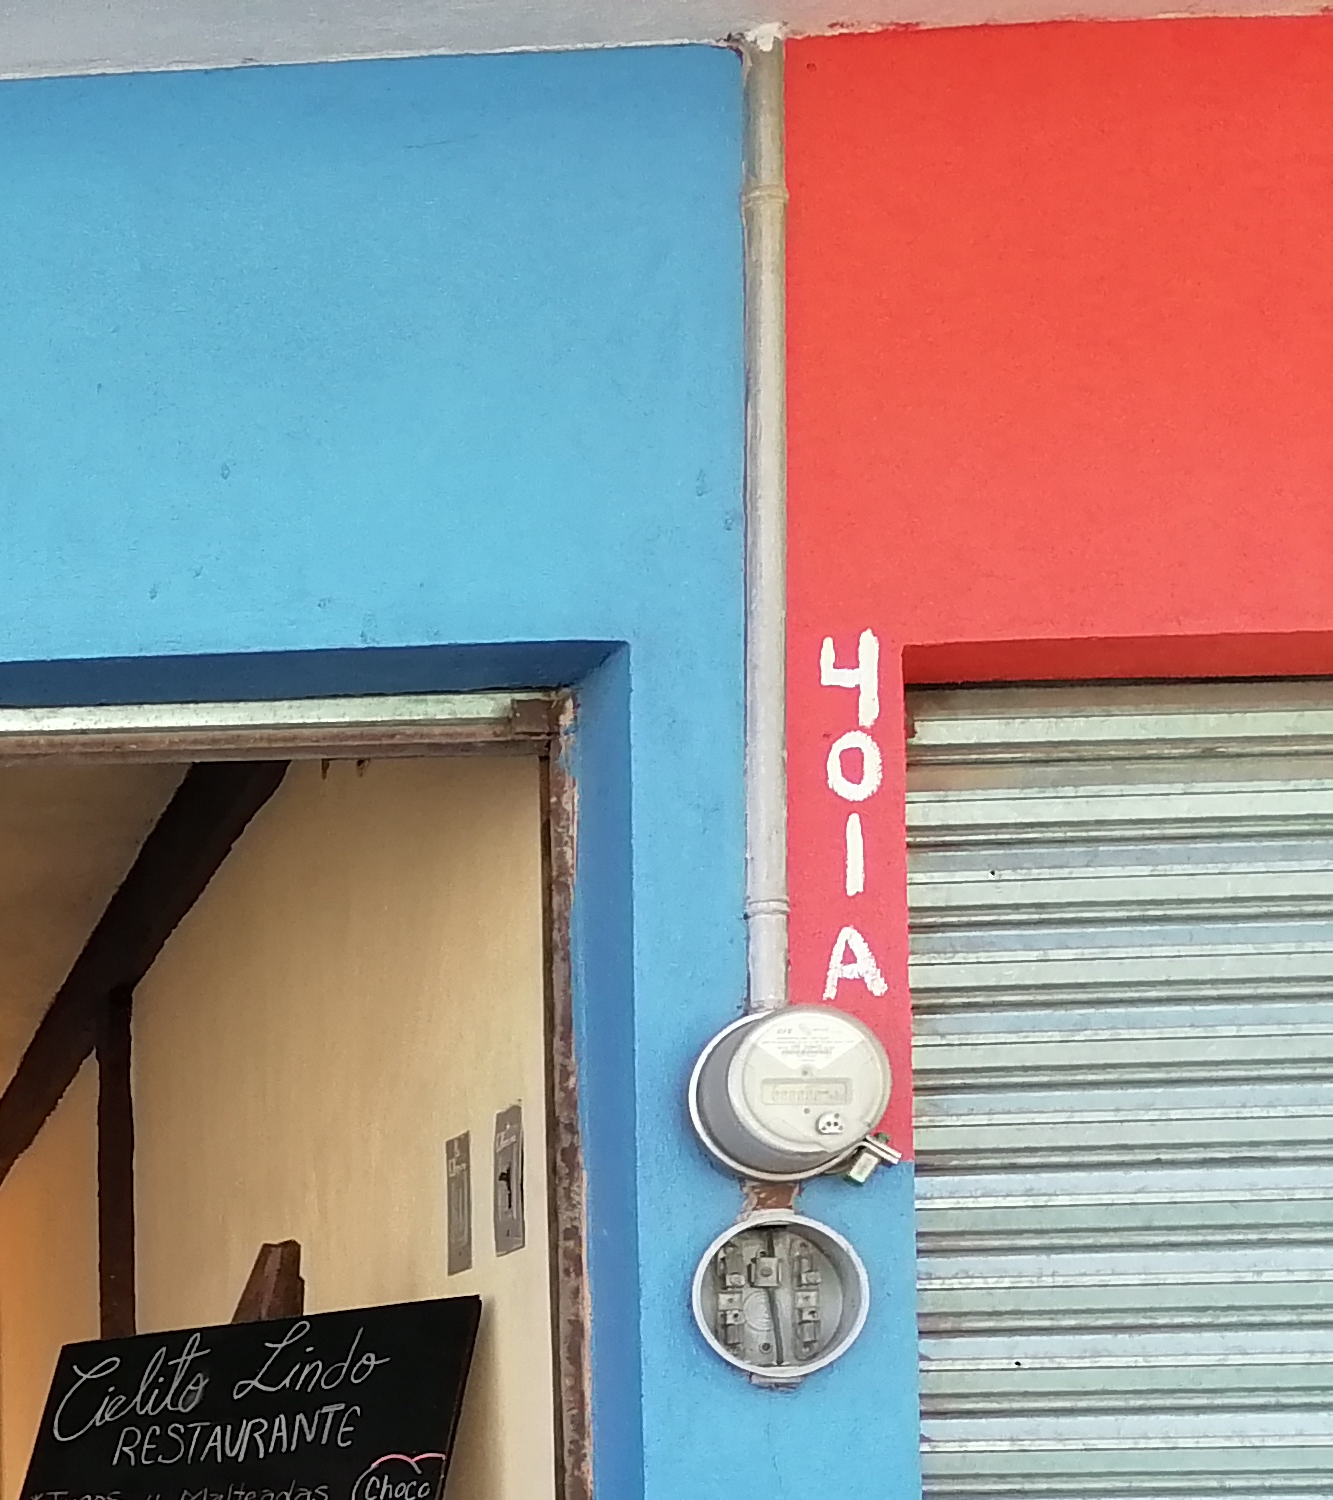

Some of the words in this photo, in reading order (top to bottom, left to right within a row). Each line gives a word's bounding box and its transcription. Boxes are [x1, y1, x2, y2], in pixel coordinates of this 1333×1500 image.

[52, 1332, 211, 1442] Cielito
[233, 1320, 391, 1400] Lindo
[111, 1403, 361, 1467] RESTAURANTE
[364, 1476, 431, 1500] Choco
